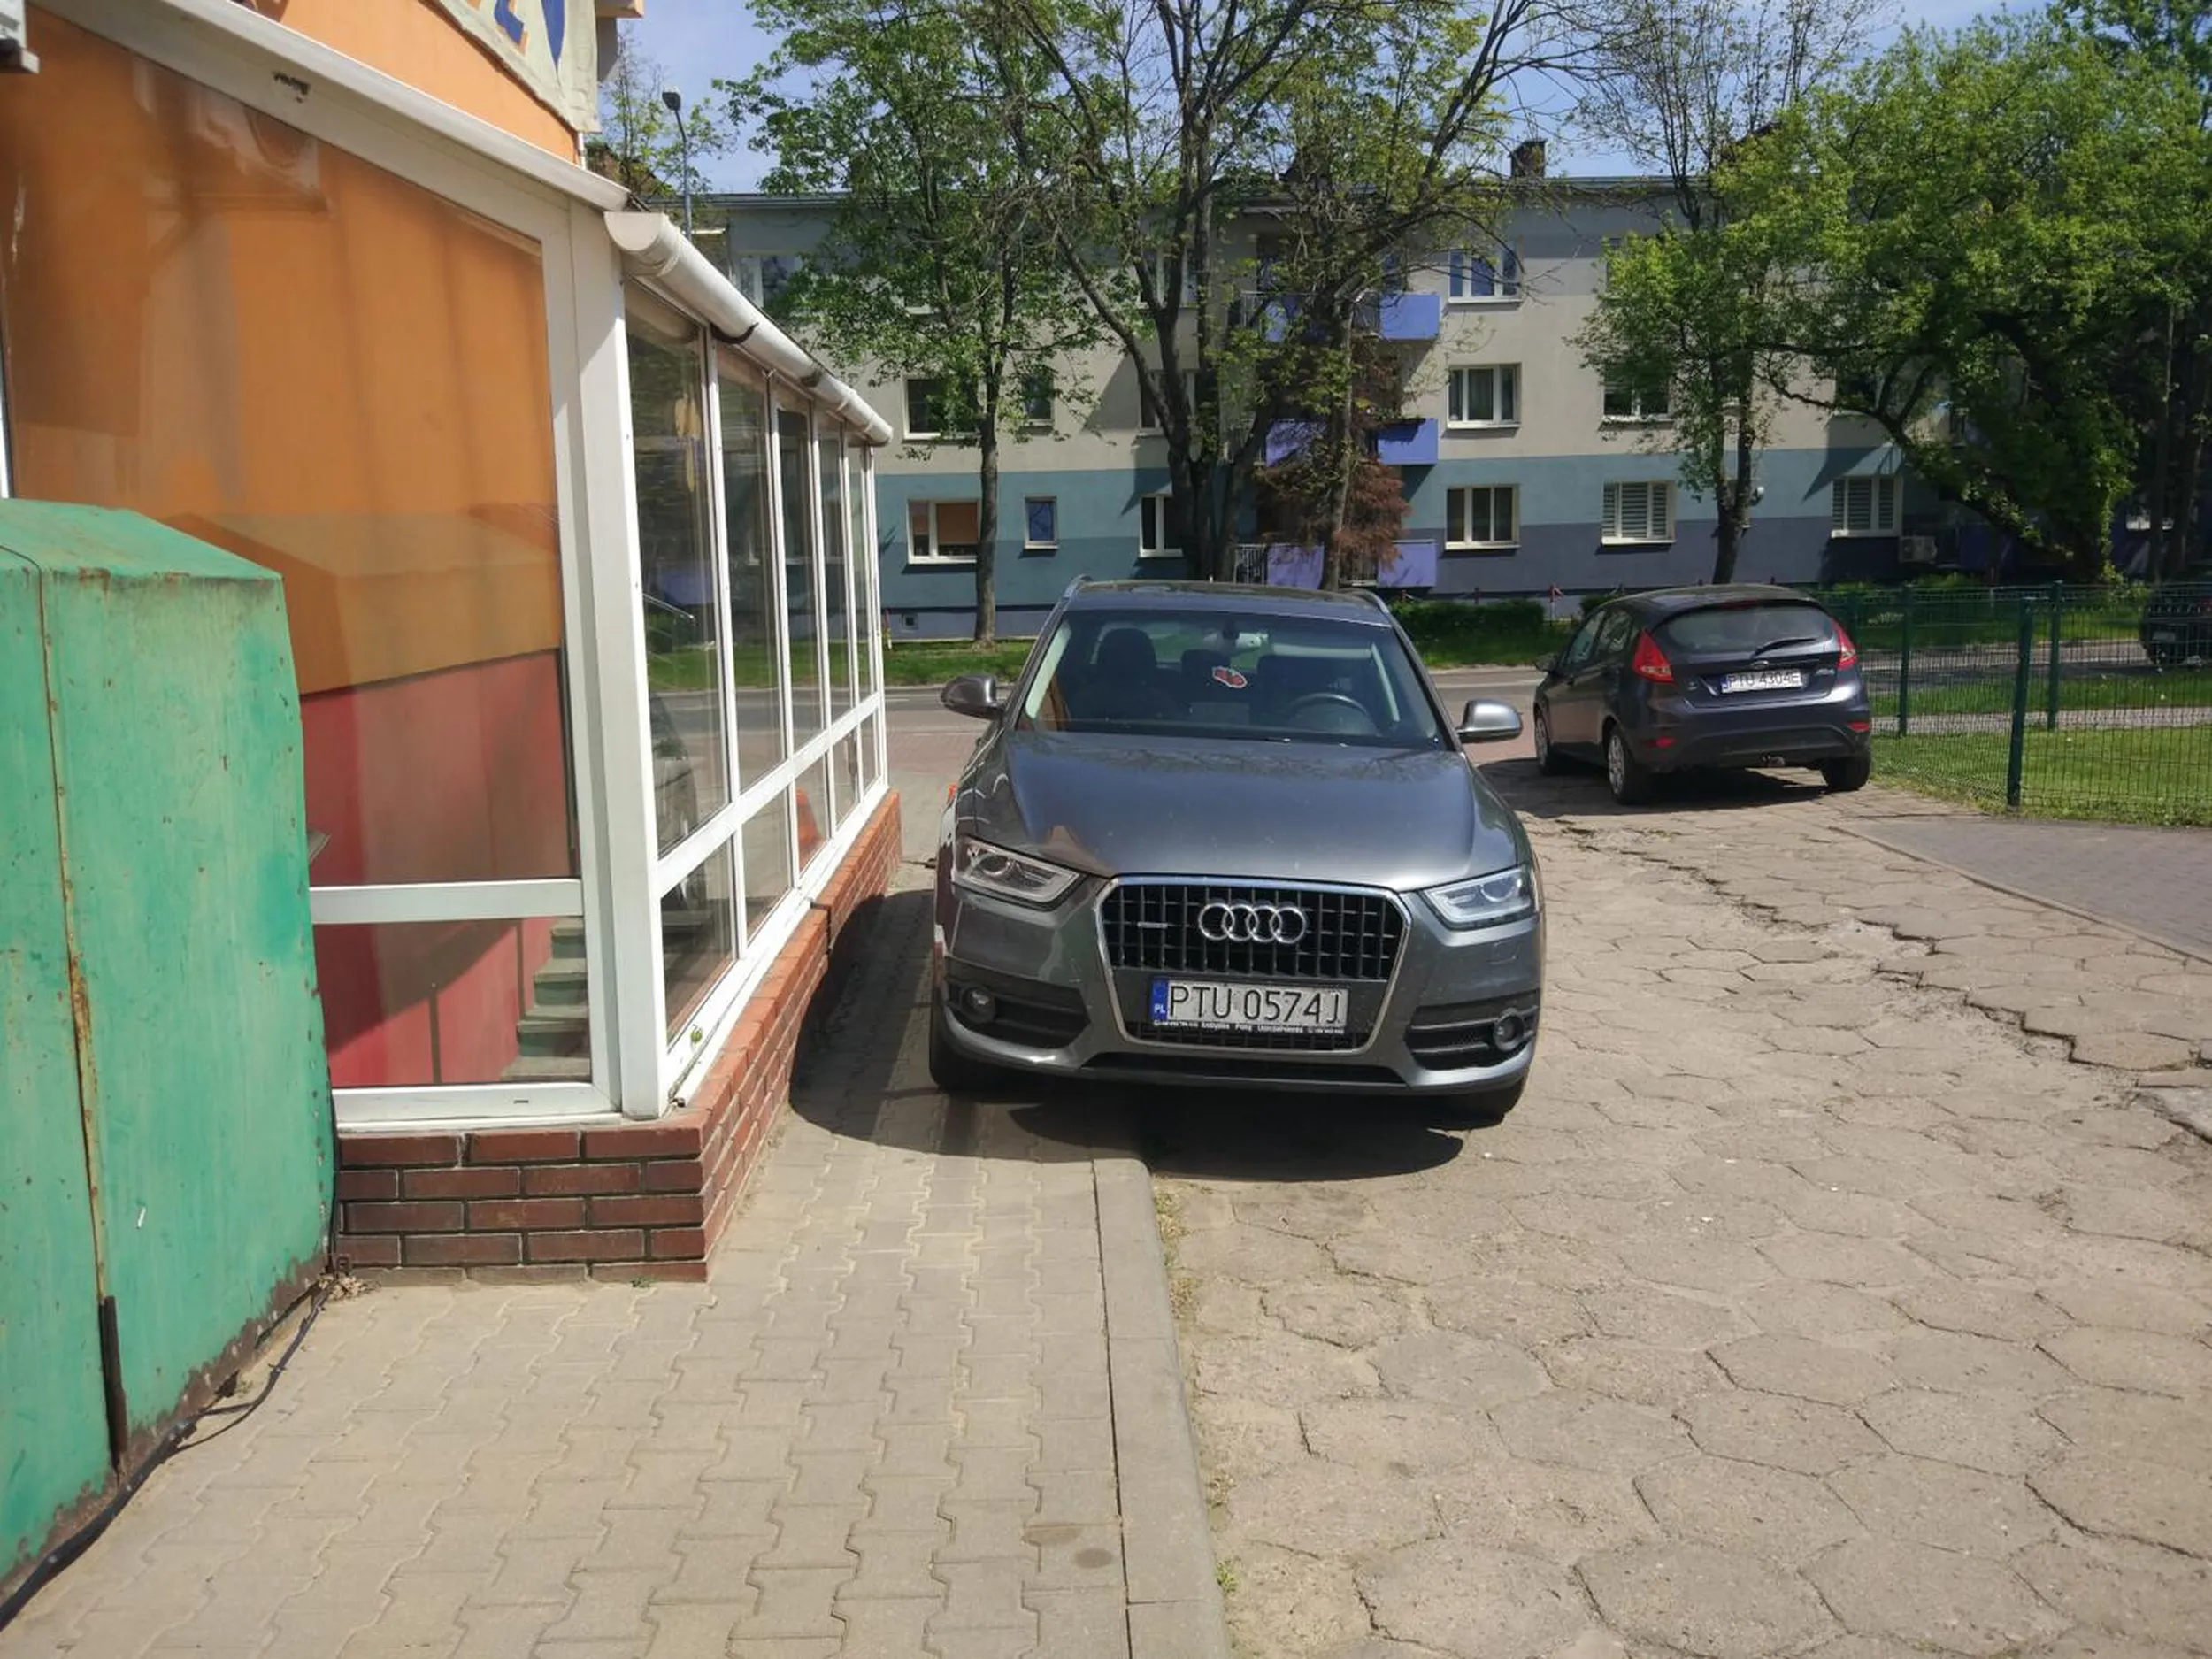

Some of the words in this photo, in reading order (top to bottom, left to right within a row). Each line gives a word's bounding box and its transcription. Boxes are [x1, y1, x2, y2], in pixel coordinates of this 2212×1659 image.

[1154, 1003, 1166, 1014] PL
[1170, 986, 1233, 1018] PTU
[1243, 989, 1341, 1025] 0574J
